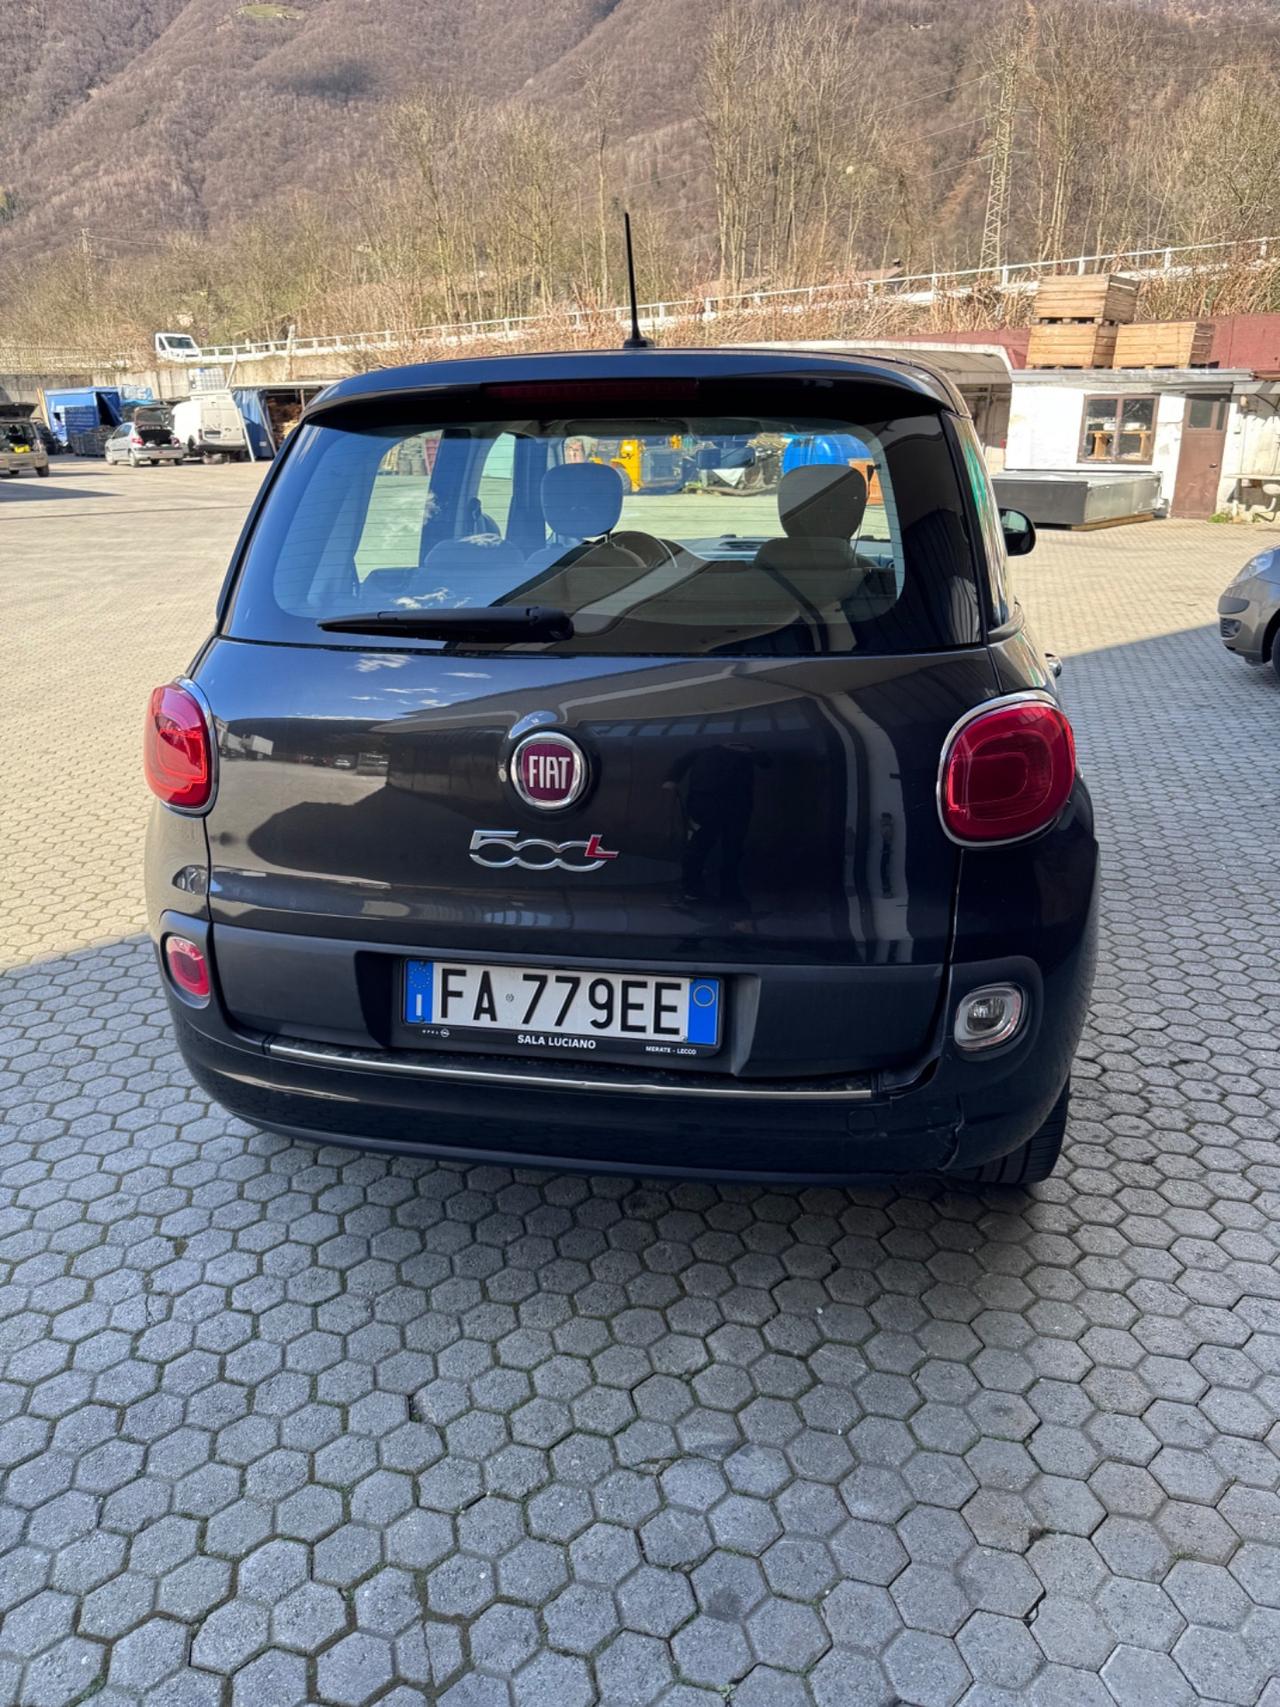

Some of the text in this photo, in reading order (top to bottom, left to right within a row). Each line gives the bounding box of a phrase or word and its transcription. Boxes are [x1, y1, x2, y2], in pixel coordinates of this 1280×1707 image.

[528, 755, 571, 790] FIAT
[469, 829, 620, 872] 500L
[517, 1034, 597, 1050] SALA LUCIANO
